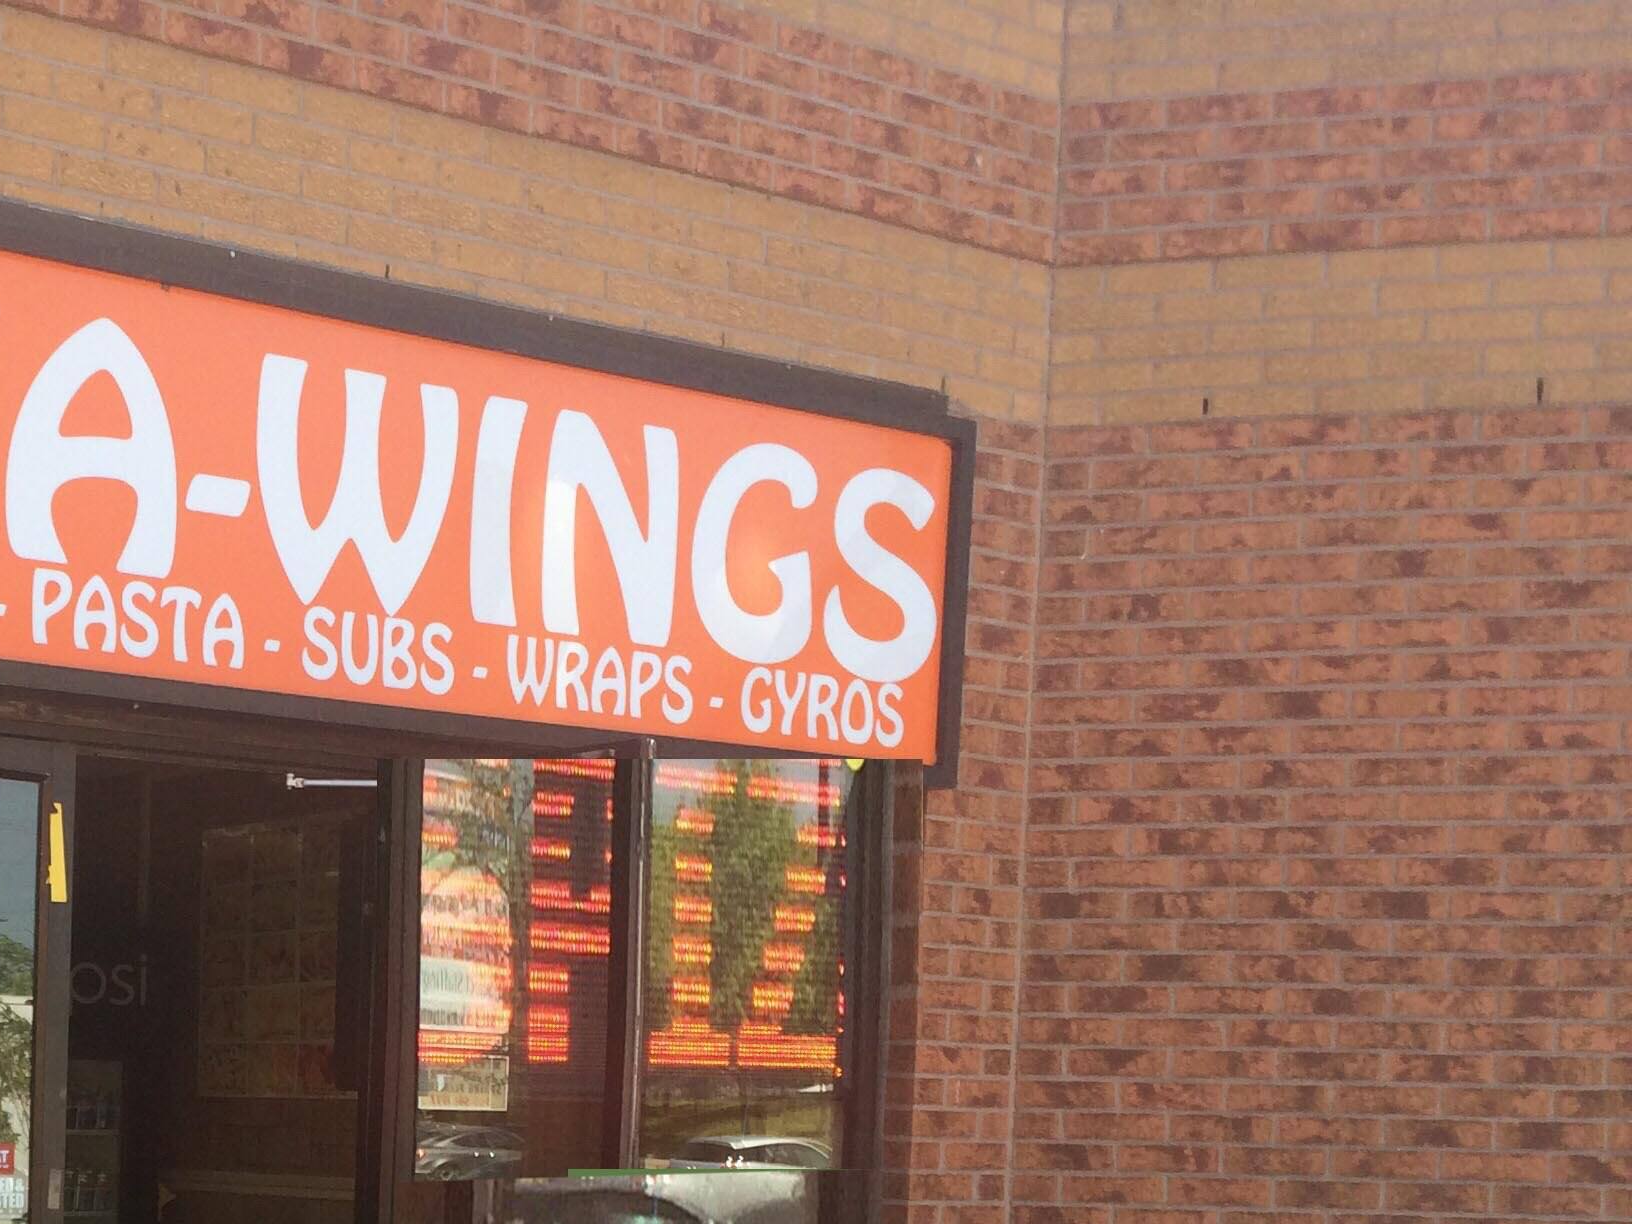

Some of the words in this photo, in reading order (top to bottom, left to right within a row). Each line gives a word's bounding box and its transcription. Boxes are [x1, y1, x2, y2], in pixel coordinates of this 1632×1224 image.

[31, 566, 245, 670] PASTA
[301, 605, 455, 696] SUBS
[506, 633, 694, 725] WRAPS
[740, 665, 905, 748] GYROS
